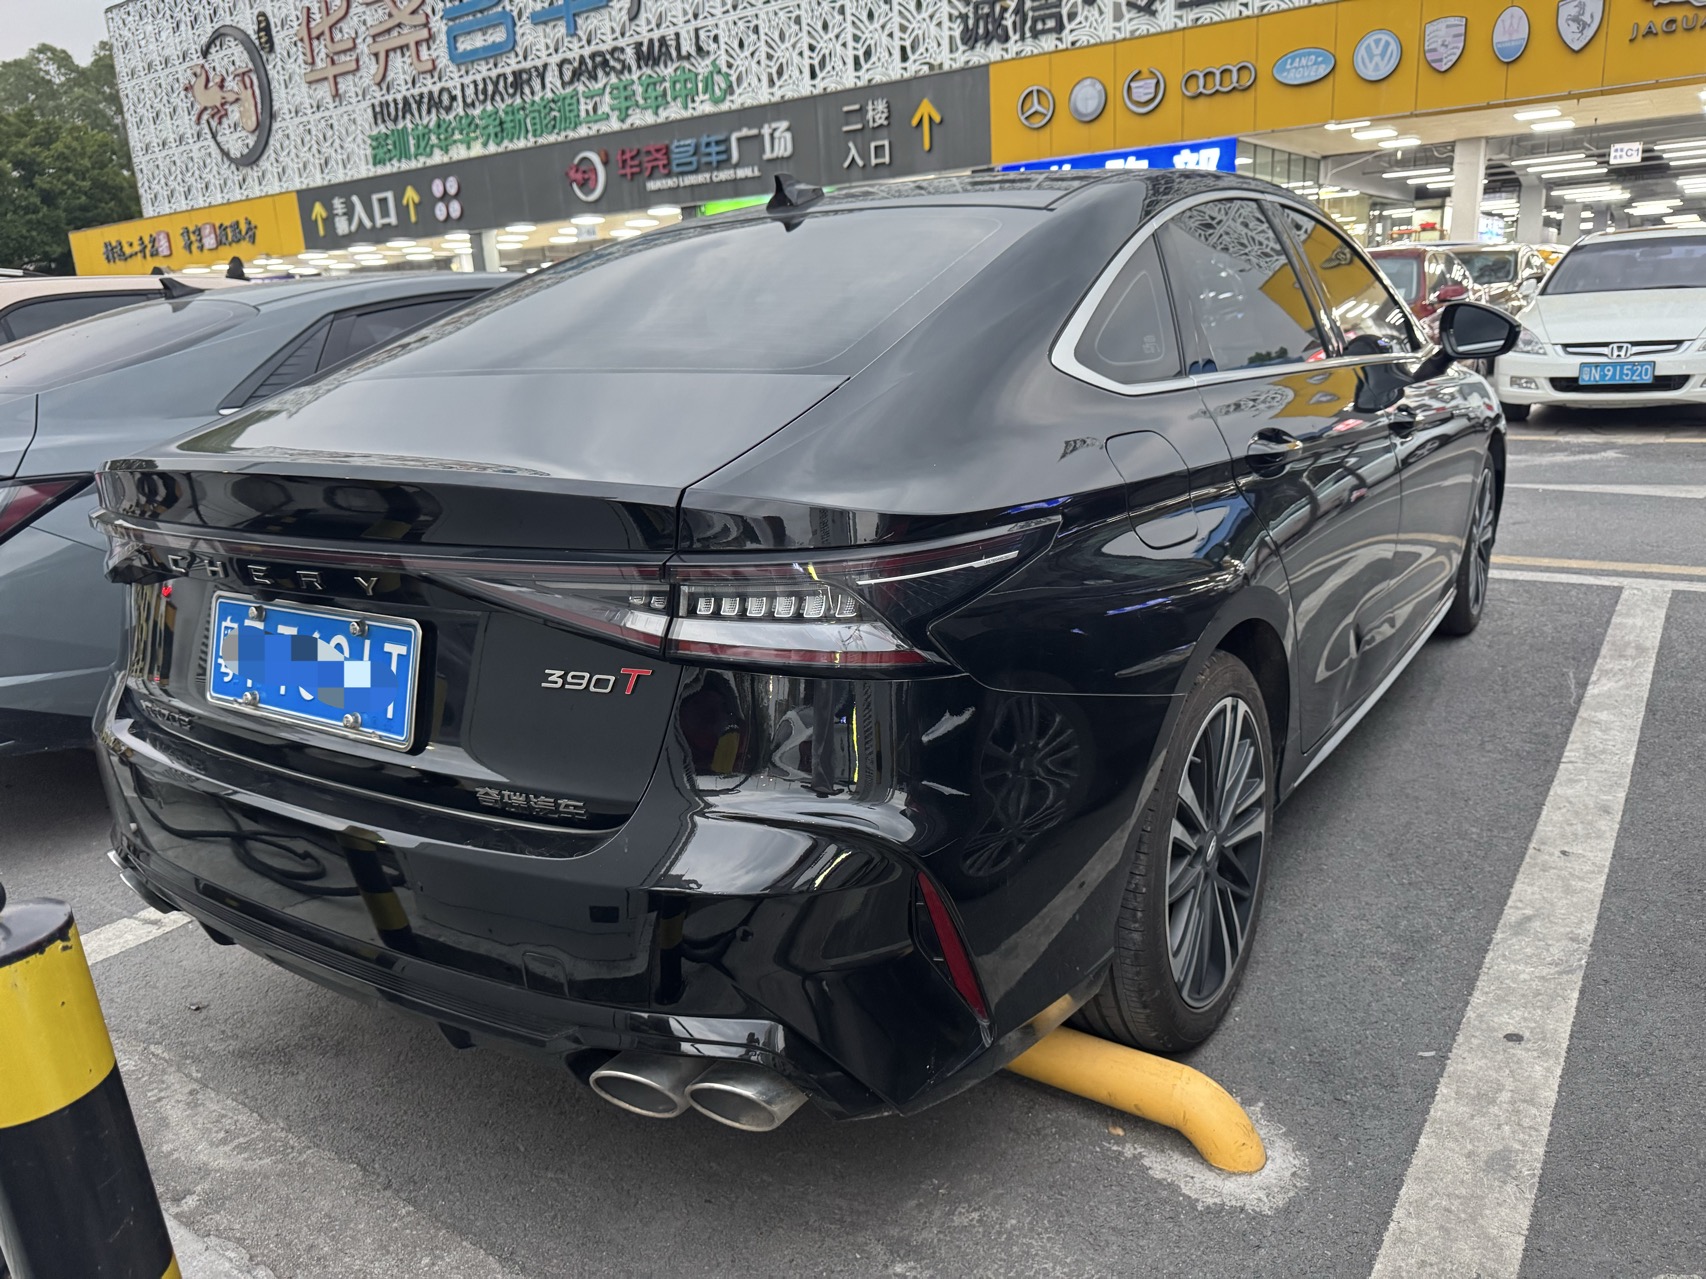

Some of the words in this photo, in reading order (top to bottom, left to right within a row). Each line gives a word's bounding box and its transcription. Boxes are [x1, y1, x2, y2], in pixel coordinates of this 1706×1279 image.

[461, 66, 549, 113] LUXURY
[558, 44, 627, 88] CARS
[635, 28, 714, 70] MALL
[841, 98, 890, 133] 二楼
[842, 138, 891, 169] 入口
[168, 554, 378, 596] CHERY
[541, 667, 653, 695] 390T
